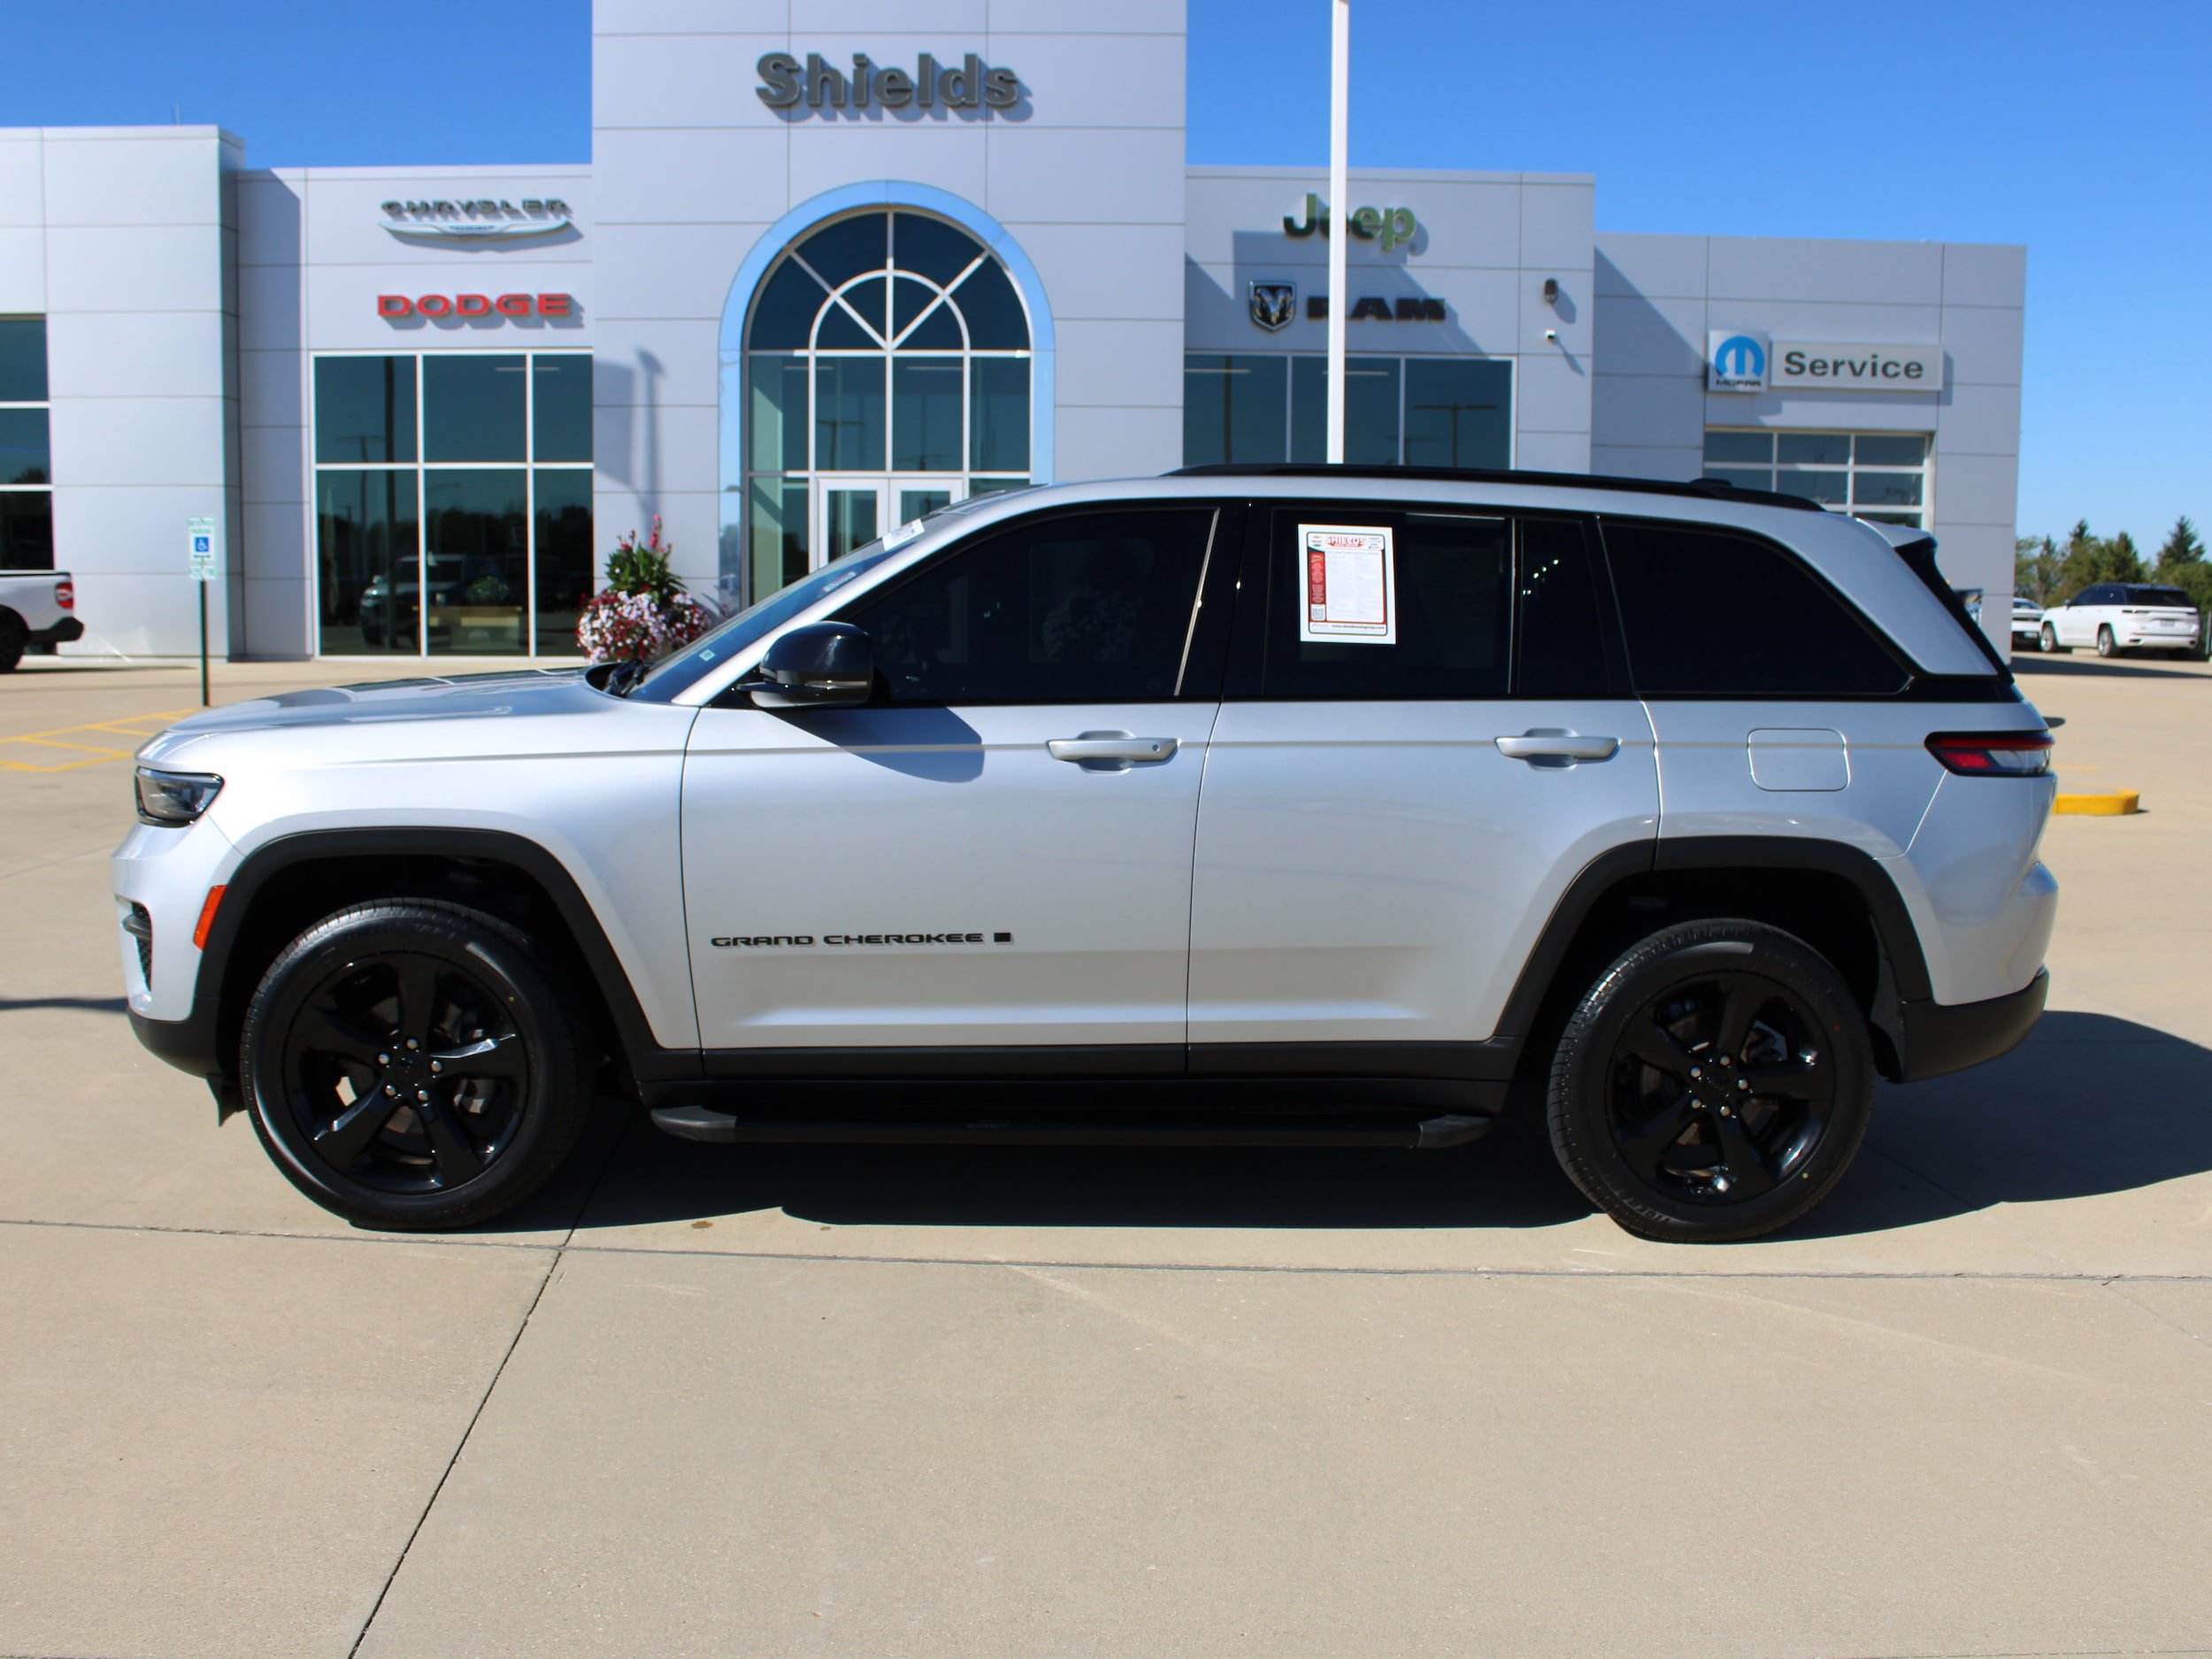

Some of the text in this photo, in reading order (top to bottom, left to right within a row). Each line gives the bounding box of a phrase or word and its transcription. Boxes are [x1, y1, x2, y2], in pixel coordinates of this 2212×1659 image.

[756, 52, 1018, 107] Shields
[380, 198, 569, 215] CHRYSLER
[378, 293, 571, 316] DODGE
[1784, 351, 1924, 379] Service
[710, 933, 984, 948] GRAND CHEROKEE
